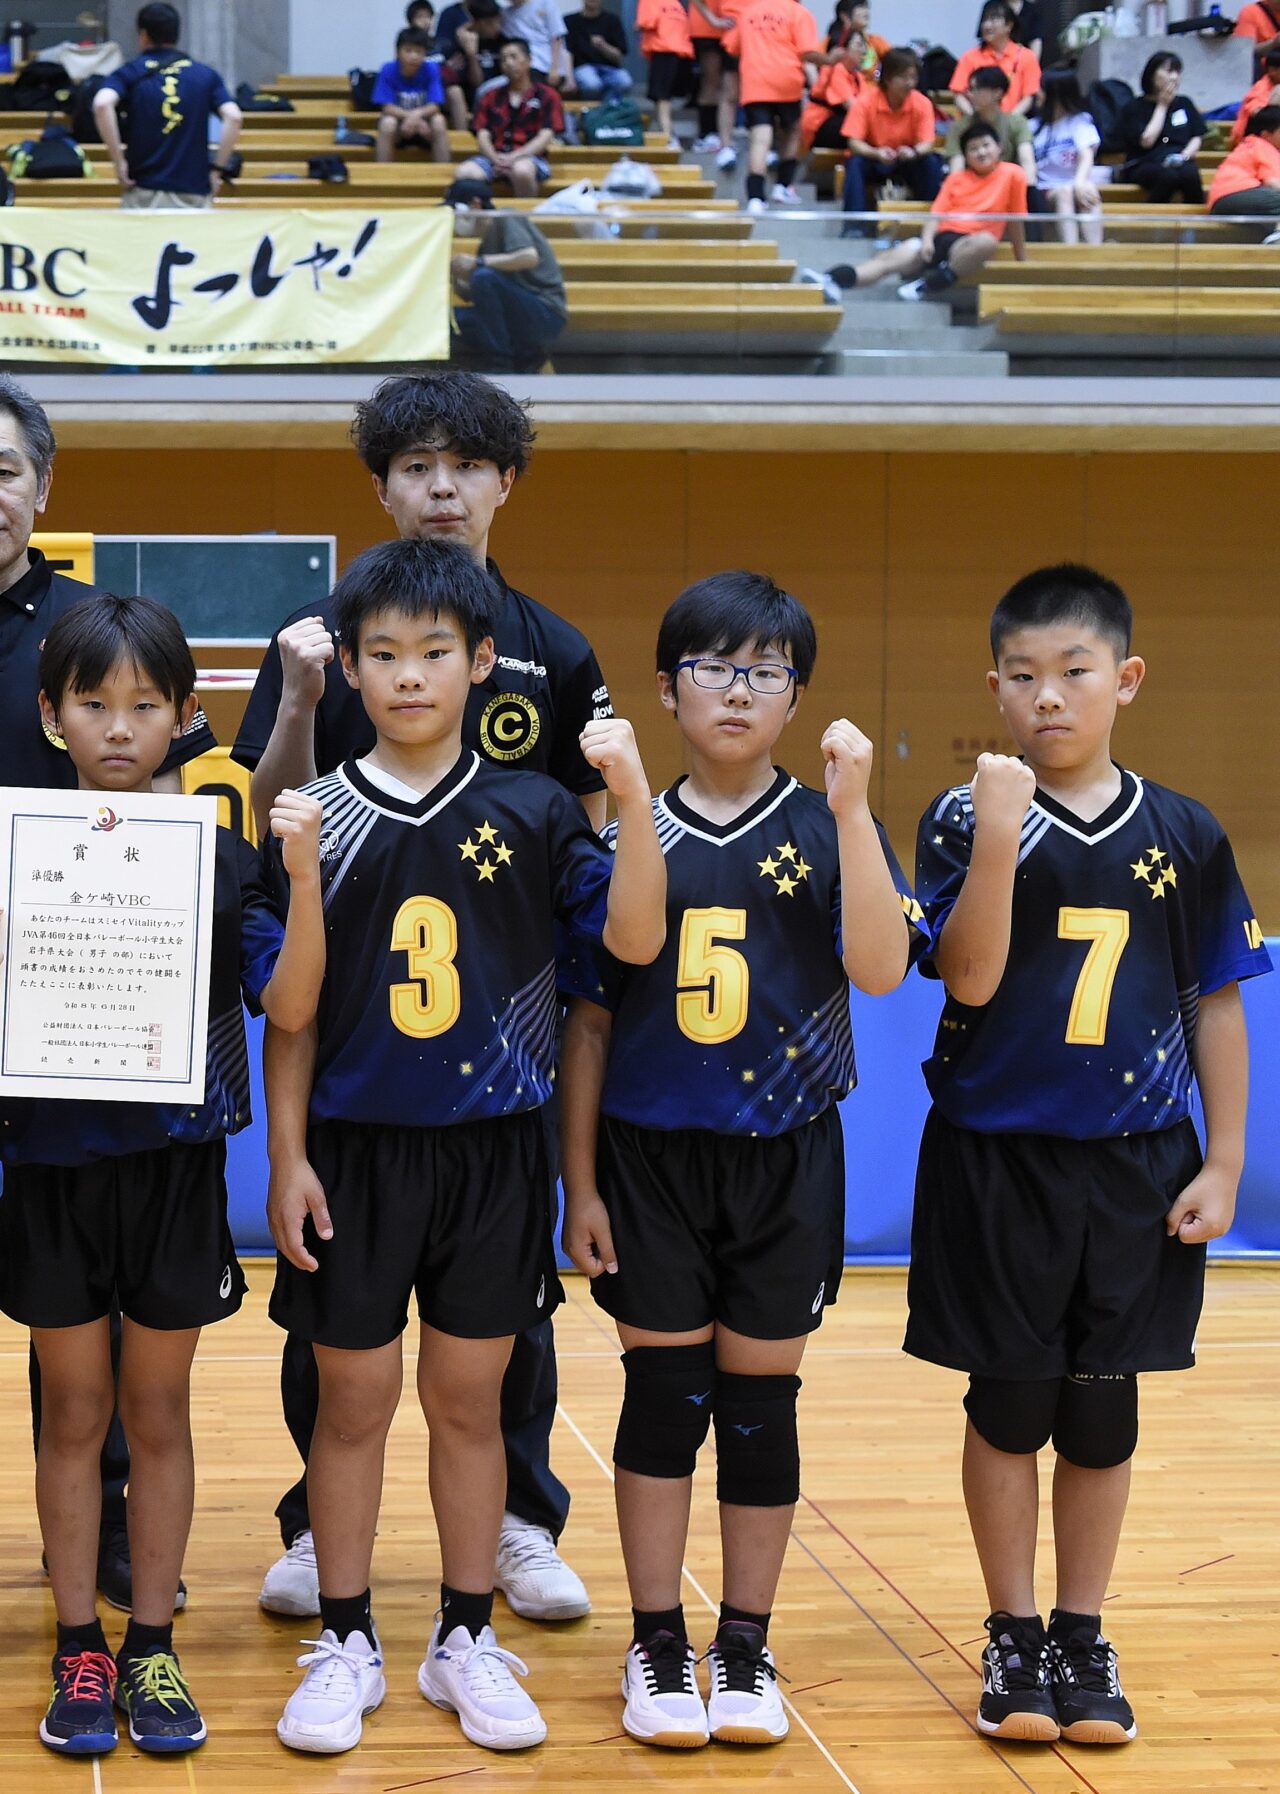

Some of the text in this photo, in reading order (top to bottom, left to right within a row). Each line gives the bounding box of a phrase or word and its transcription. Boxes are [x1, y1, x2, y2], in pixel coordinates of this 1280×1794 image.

[32, 303, 86, 318] TEAM
[483, 692, 534, 717] KANEGASAKI
[494, 711, 523, 741] C
[322, 850, 342, 862] TRES
[31, 869, 65, 883] 準優勝
[389, 895, 460, 1039] 3
[676, 906, 750, 1045] 5
[1058, 906, 1130, 1046] 7
